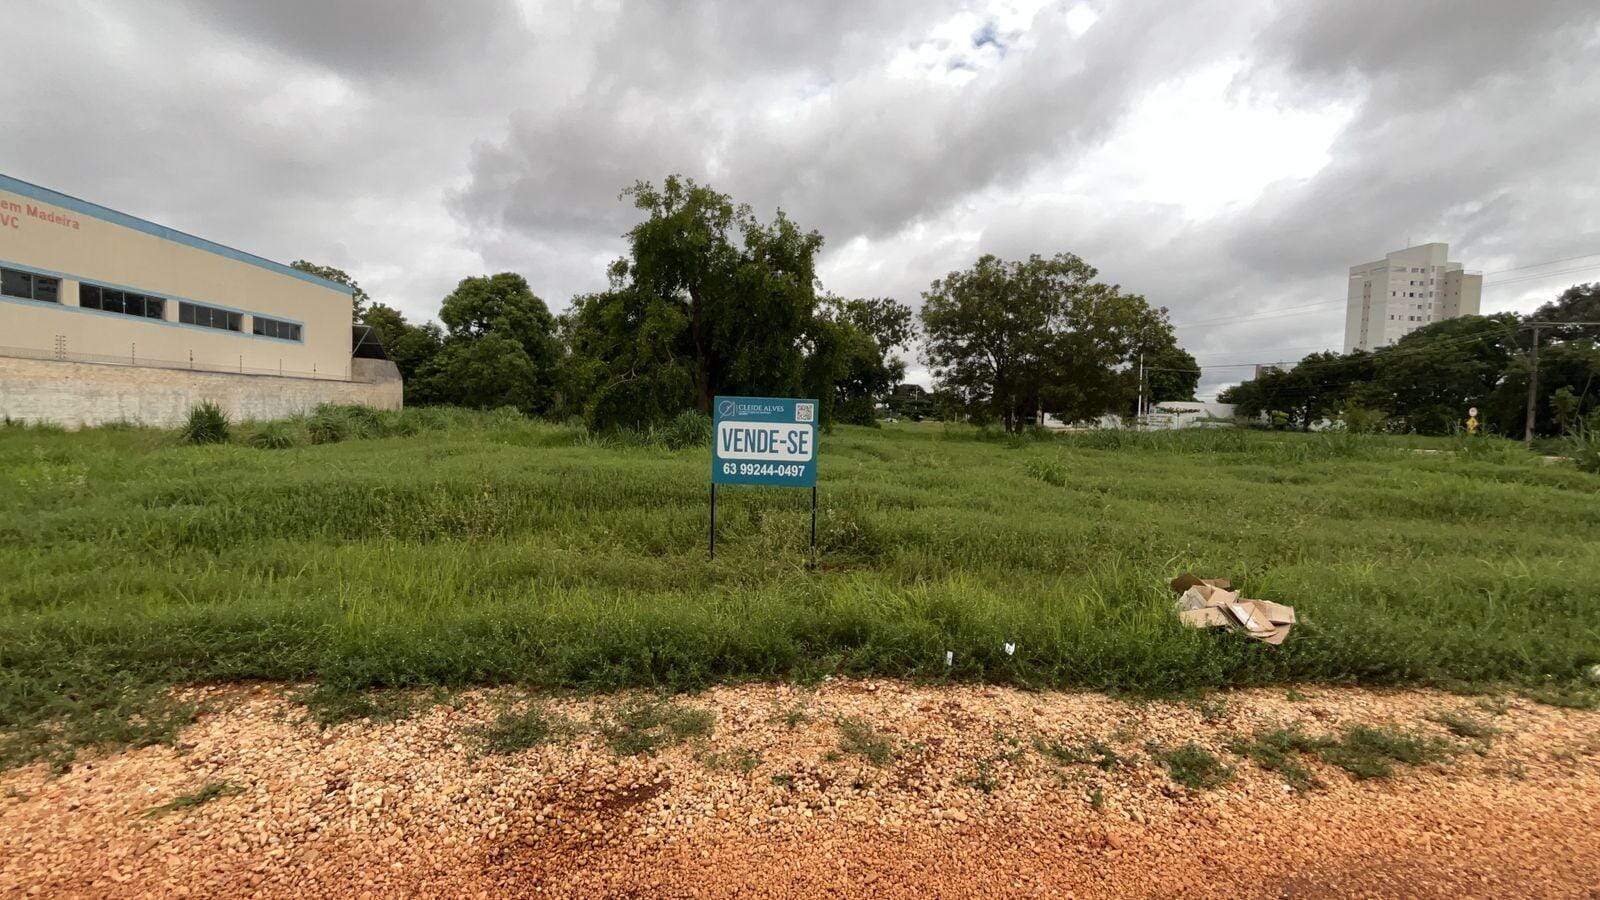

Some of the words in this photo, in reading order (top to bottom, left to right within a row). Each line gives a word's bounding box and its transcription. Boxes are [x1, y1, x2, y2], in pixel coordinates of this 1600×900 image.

[0, 199, 21, 213] em
[26, 204, 80, 230] Madeira
[722, 428, 809, 455] VENDE-SE
[723, 462, 737, 475] 63
[740, 463, 805, 477] 99244-0497
